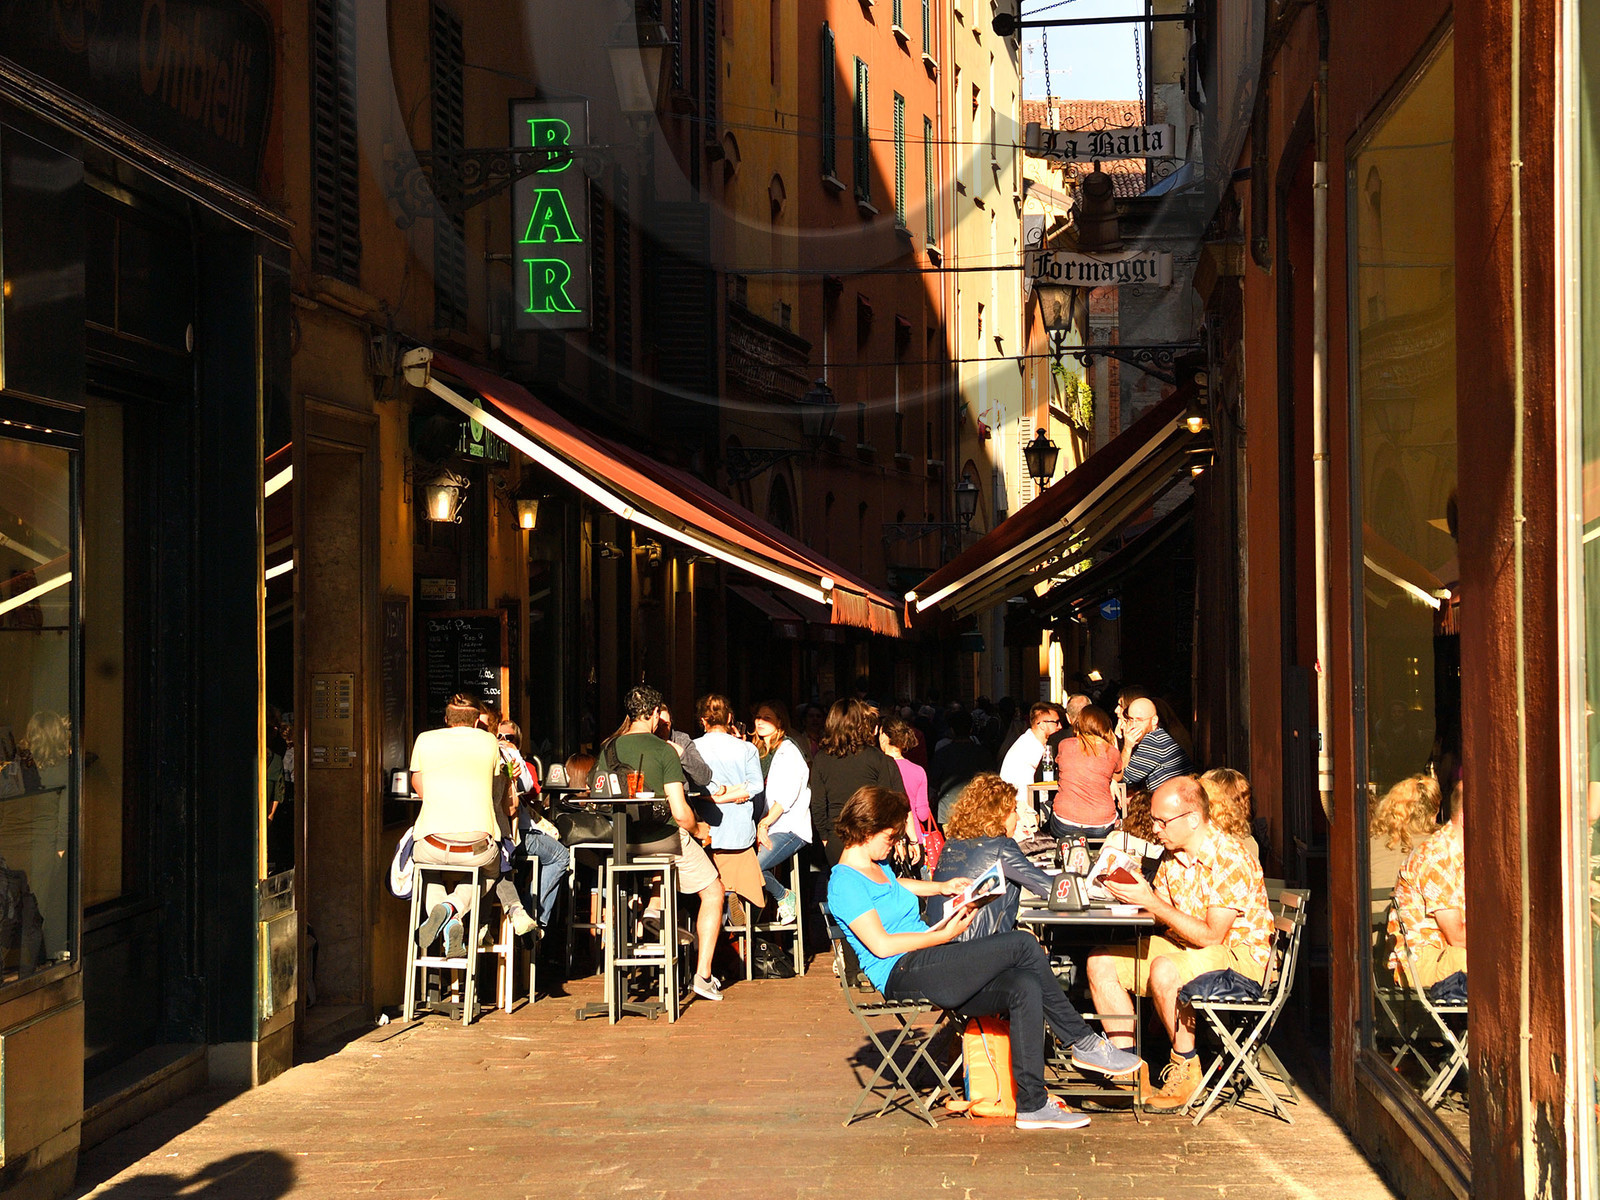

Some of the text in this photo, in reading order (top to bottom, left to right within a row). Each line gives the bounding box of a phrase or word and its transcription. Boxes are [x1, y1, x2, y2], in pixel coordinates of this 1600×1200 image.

[1041, 127, 1164, 162] La Baita
[518, 117, 583, 314] BAR
[1030, 251, 1157, 283] Formaggi
